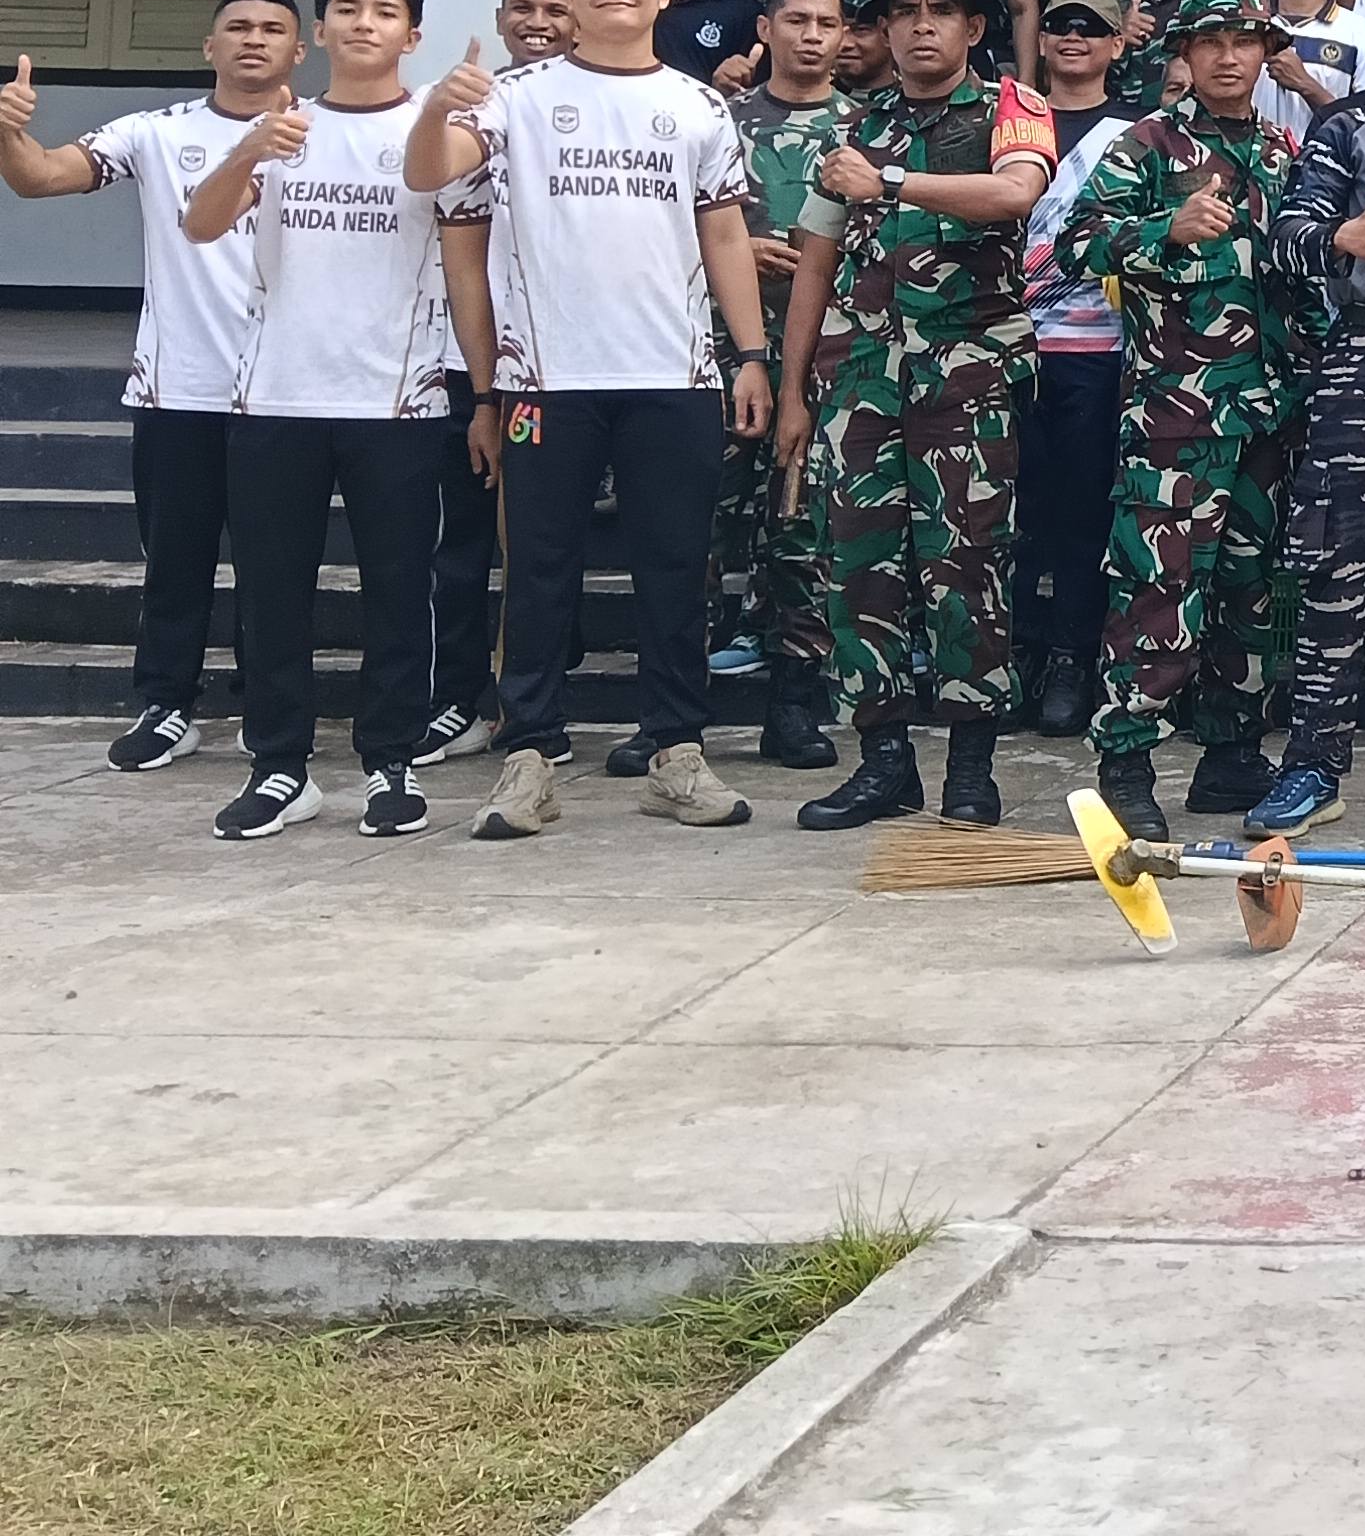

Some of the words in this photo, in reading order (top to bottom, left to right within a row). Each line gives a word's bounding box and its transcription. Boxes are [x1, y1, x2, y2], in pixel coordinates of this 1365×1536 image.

[559, 147, 674, 174] KEJAKSAAN
[281, 180, 395, 206] KEJAKSAAN
[549, 175, 620, 197] BANDA
[626, 176, 678, 203] NEIRA
[280, 208, 336, 232] ANDA
[342, 211, 399, 234] NEIRA
